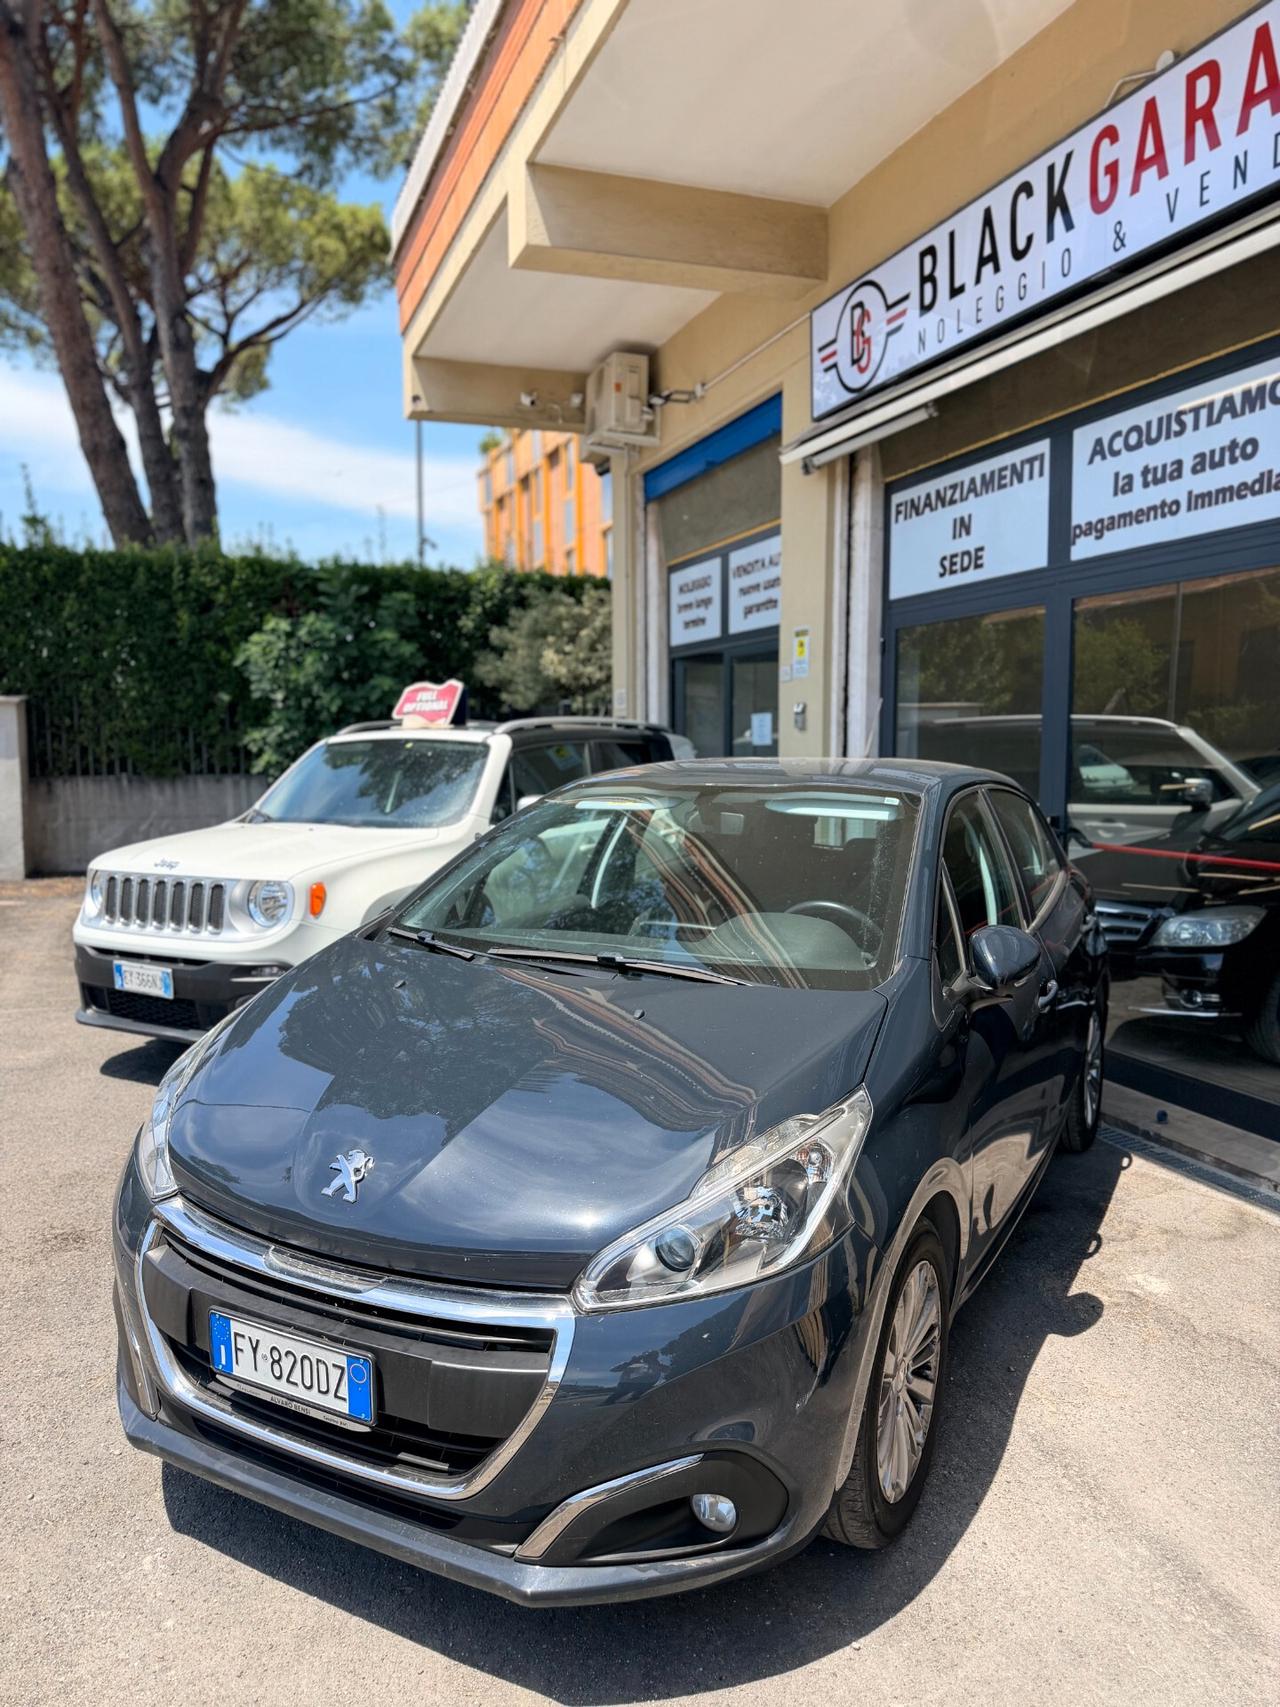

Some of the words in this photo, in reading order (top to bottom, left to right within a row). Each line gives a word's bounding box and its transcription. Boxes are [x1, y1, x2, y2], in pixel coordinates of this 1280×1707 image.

[918, 247, 1072, 355] NOLEGGIO
[1112, 220, 1127, 252] &
[1087, 375, 1280, 466] ACQUISTIAMO
[894, 452, 1046, 524] FINANZIAMENTI
[1112, 470, 1134, 498] la
[1140, 458, 1184, 490] tua
[1190, 436, 1260, 476] auto
[952, 513, 973, 541] IN
[1071, 498, 1181, 547] pagamento
[938, 545, 986, 579] SEDE
[233, 1330, 261, 1372] FY
[269, 1345, 348, 1402] 820DZ
